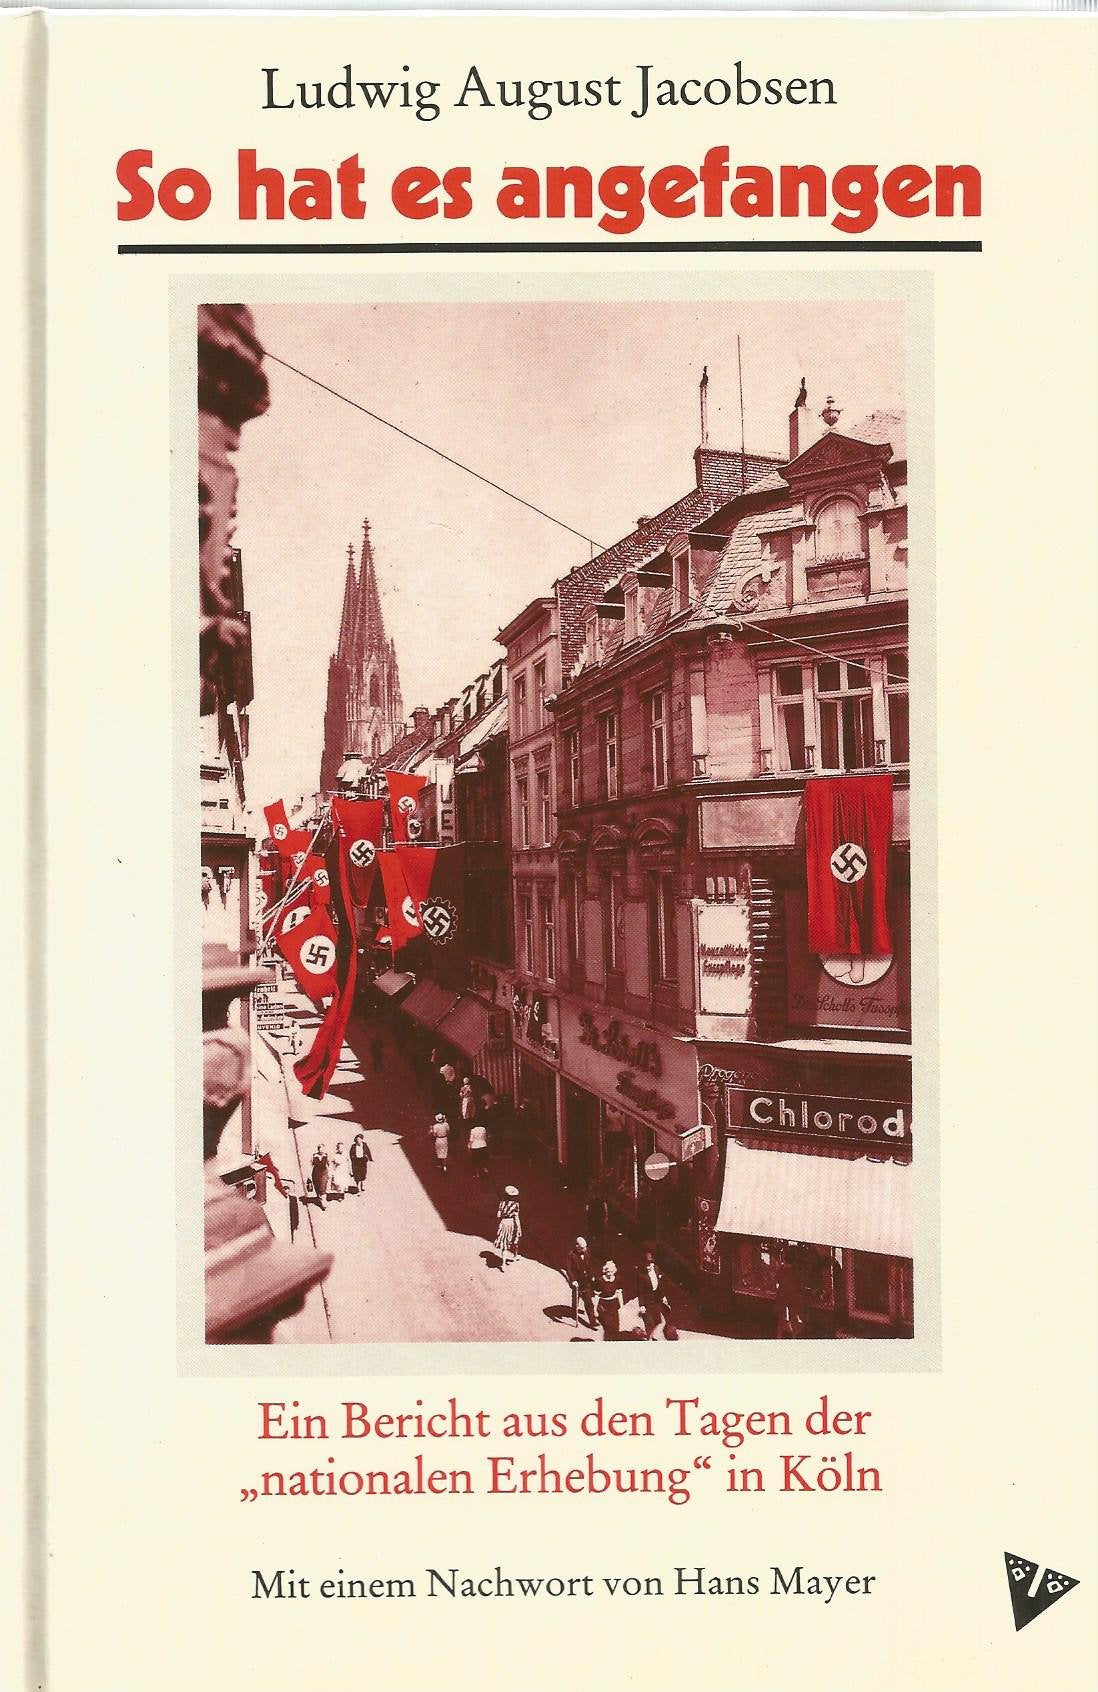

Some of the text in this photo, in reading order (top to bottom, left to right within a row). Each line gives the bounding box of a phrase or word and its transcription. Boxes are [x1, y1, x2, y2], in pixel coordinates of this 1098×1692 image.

[261, 61, 837, 121] Ludwig August Jacobsen
[116, 146, 981, 234] So hat es angefangen
[749, 1096, 912, 1139] Chlorod
[258, 1395, 871, 1448] Ein Bericht aus den Tagen der
[240, 1452, 883, 1505] „nationalen Erhebung“ in Köln
[252, 1566, 877, 1605] Mit einem Nachwort von Hans Mayer
